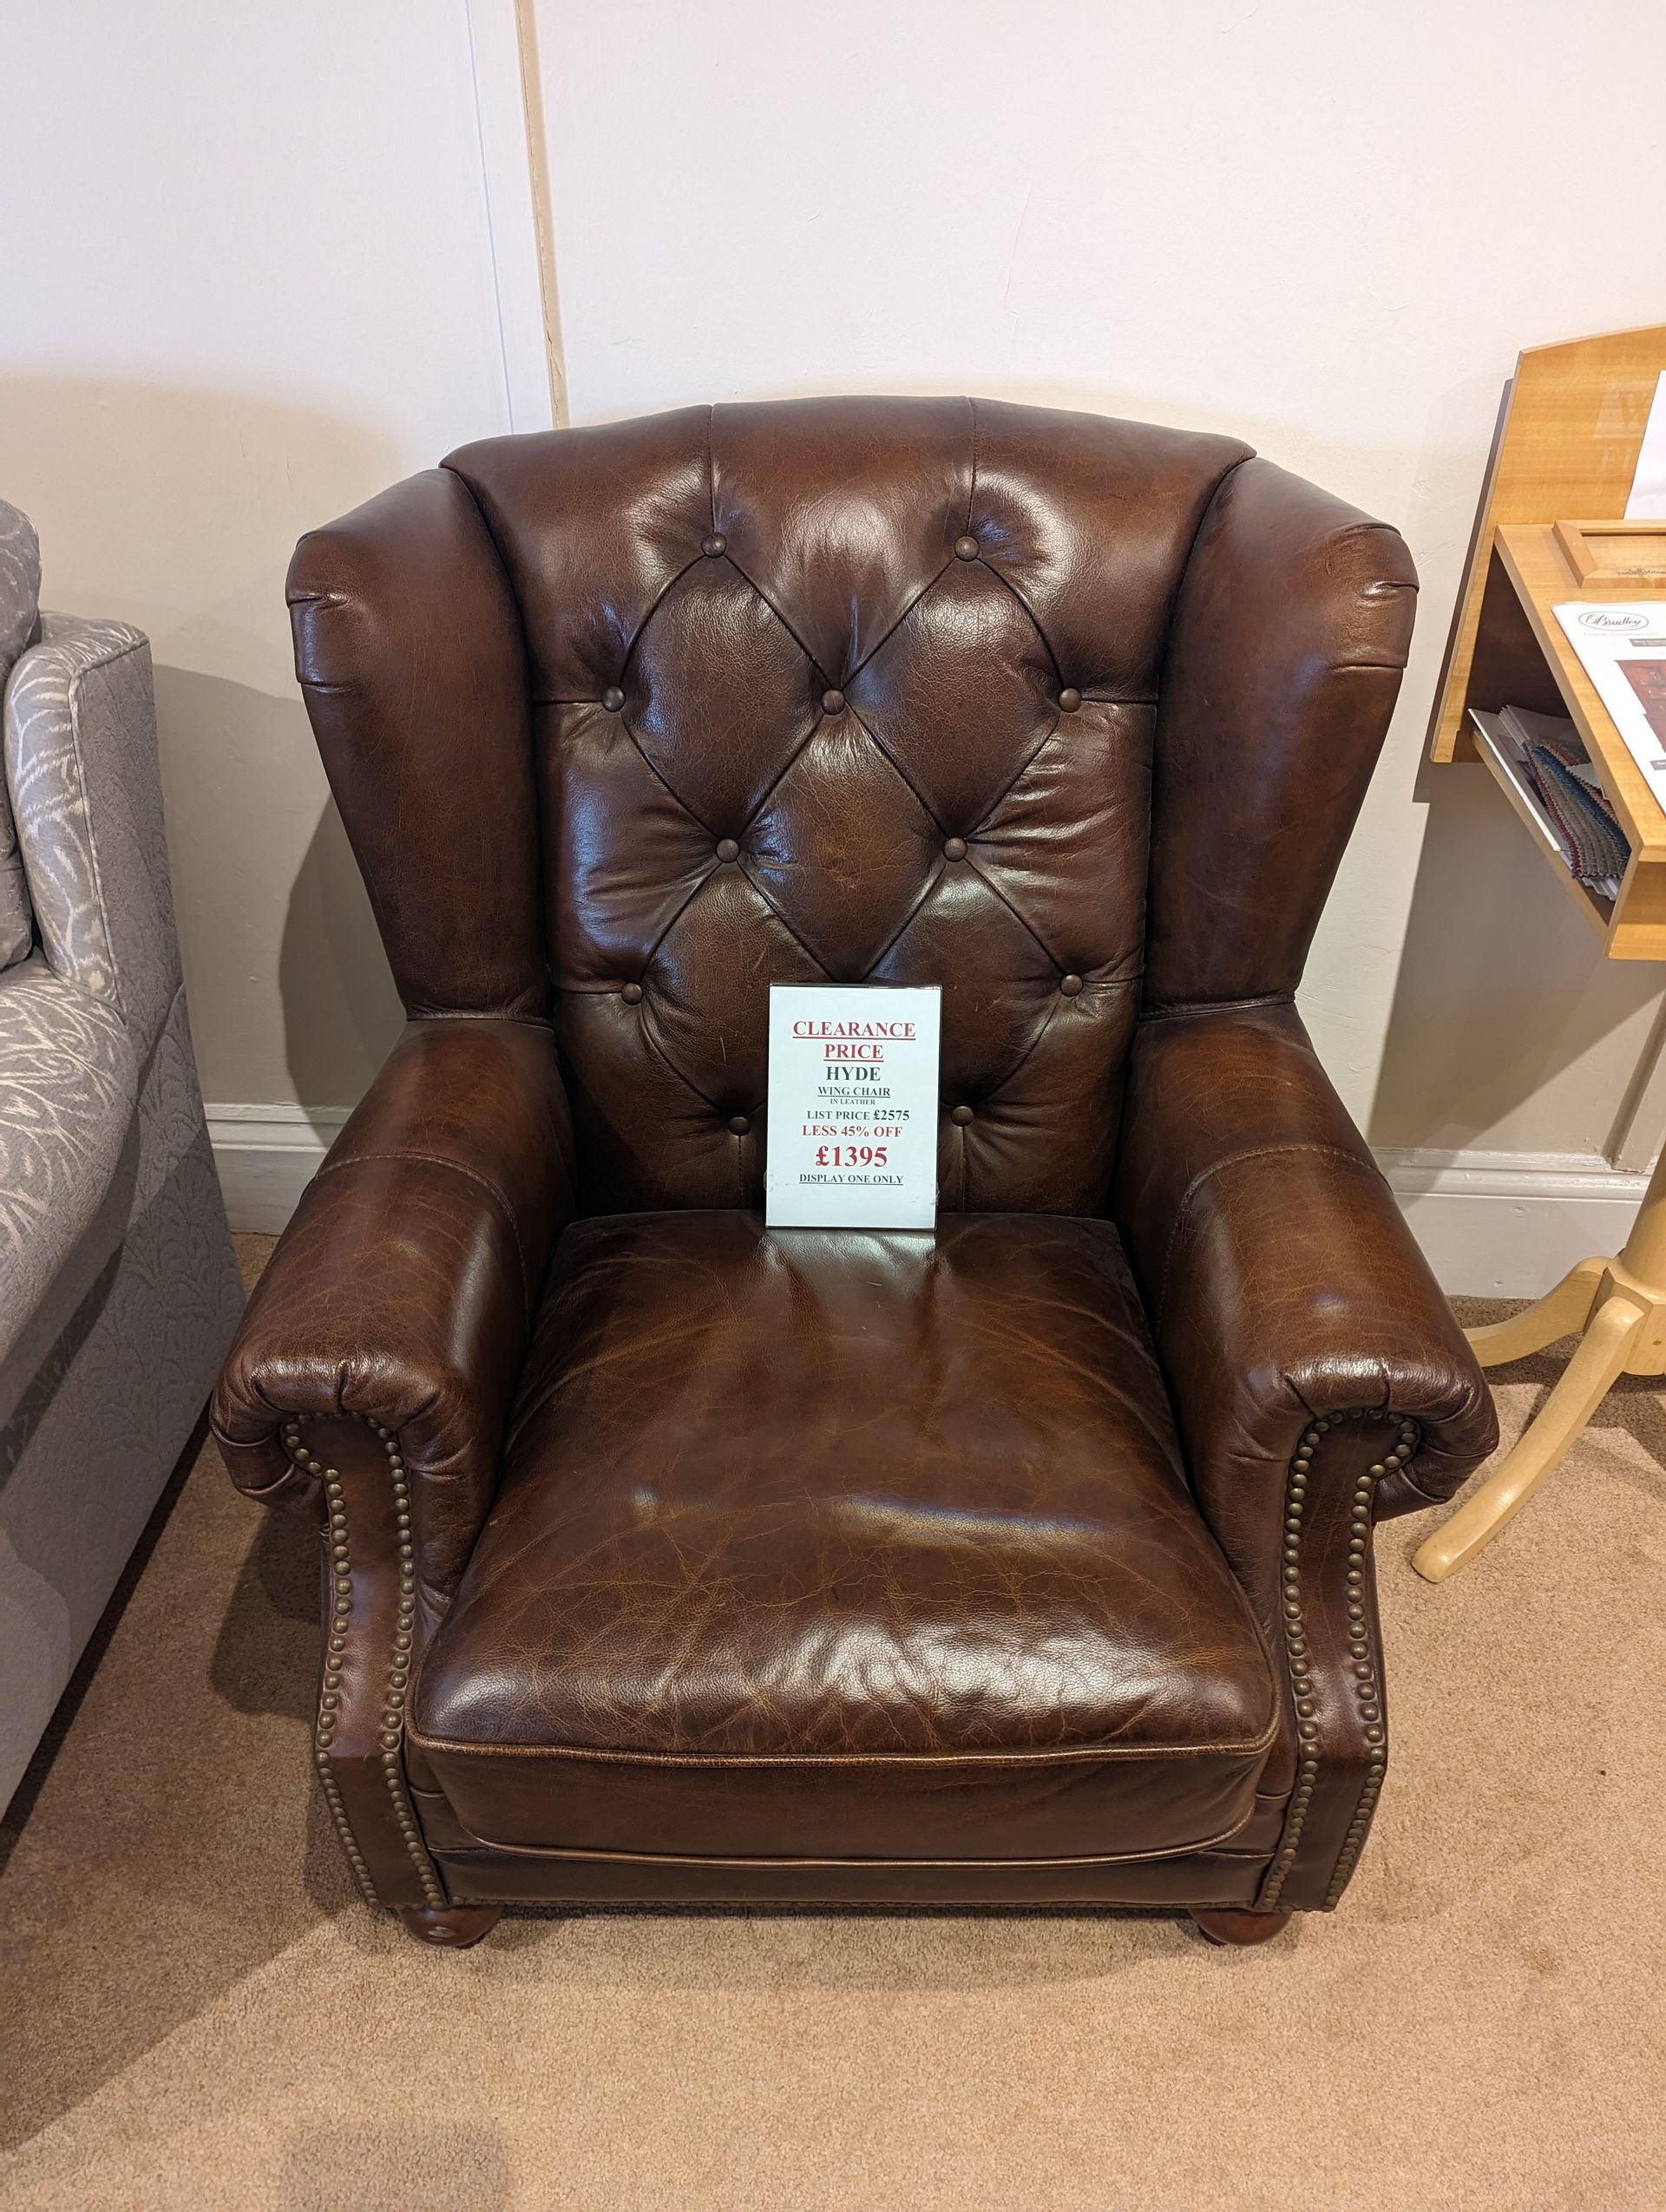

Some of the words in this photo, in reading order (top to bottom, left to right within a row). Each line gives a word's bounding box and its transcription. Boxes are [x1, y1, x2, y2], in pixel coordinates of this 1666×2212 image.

[792, 1020, 915, 1037] CLEARANCE
[824, 1044, 883, 1059] PRICE
[825, 1066, 881, 1081] HYDE
[817, 1086, 849, 1096] WING
[853, 1087, 890, 1096] CHAIR
[806, 1110, 832, 1120] LIST
[836, 1111, 870, 1121] PRICE
[873, 1109, 909, 1121] £2575
[802, 1125, 836, 1136] LESS
[841, 1126, 869, 1137] 45%
[874, 1127, 902, 1137] OFF
[815, 1145, 888, 1168] £1395
[799, 1174, 845, 1183] DISPLAY
[848, 1175, 870, 1183] ONE
[873, 1175, 903, 1184] ONLY
